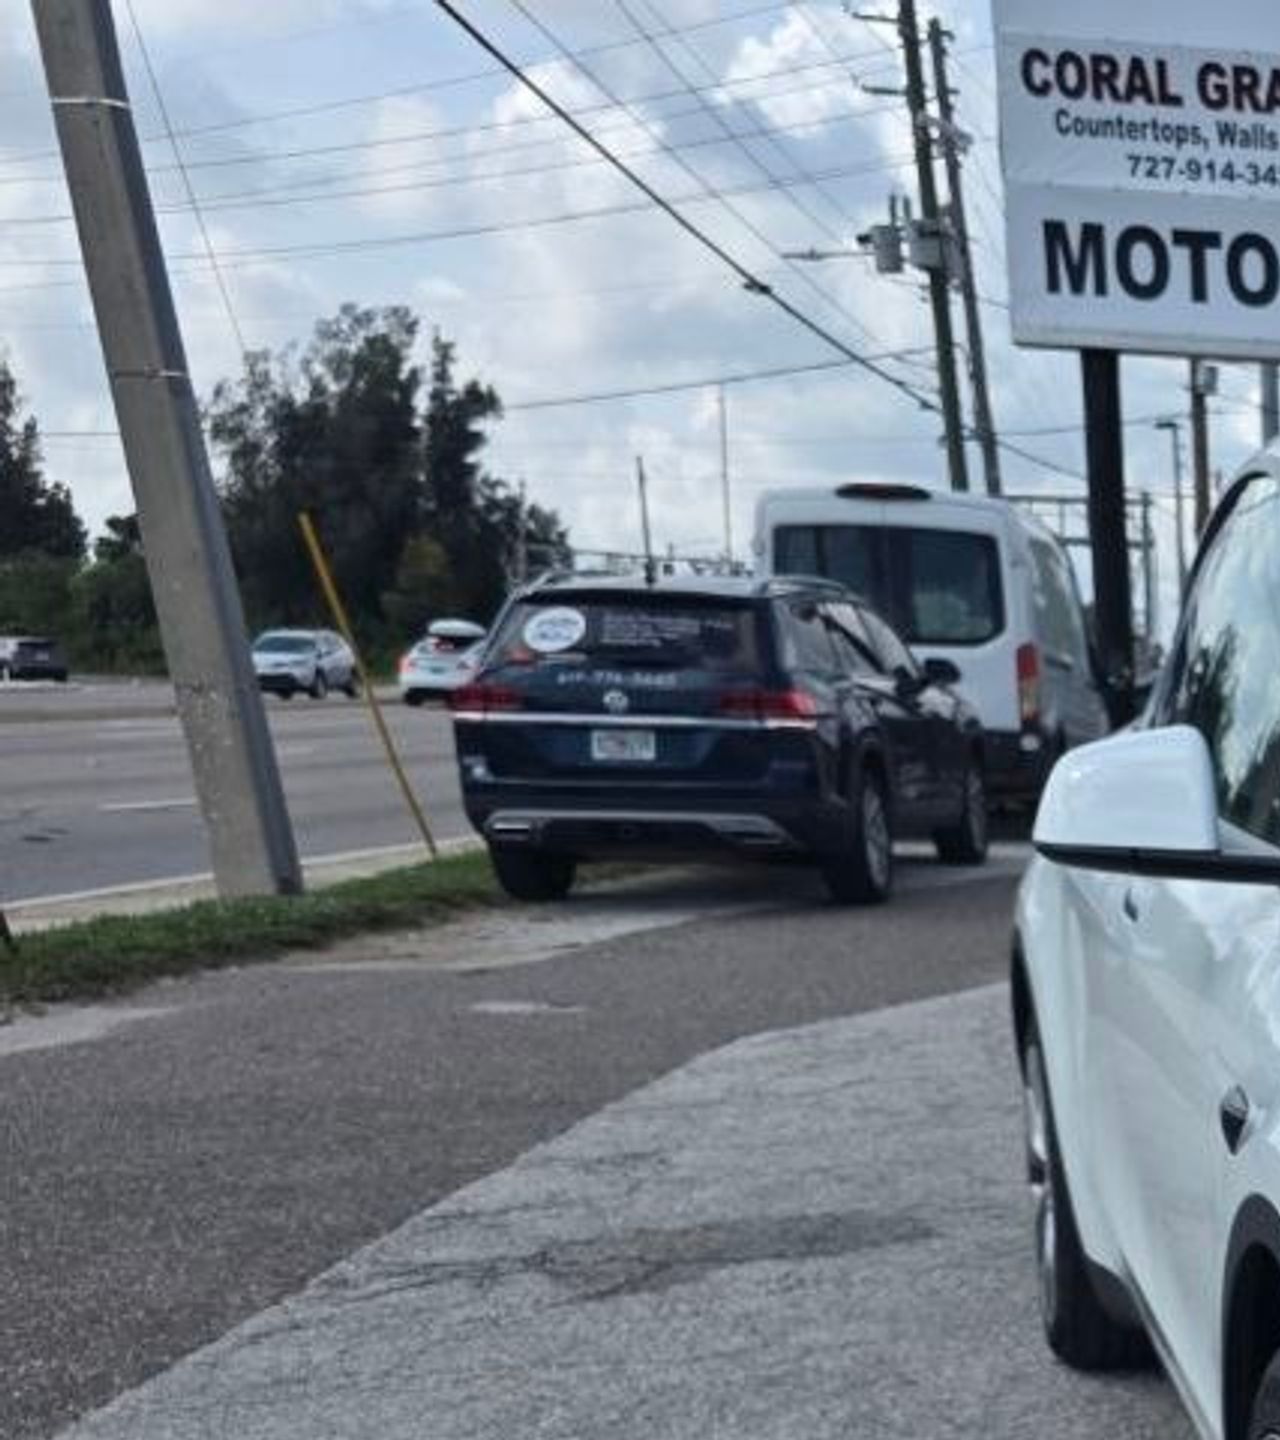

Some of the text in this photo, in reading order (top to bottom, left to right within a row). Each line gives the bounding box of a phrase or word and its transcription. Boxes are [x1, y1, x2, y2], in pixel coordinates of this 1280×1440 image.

[1020, 48, 1184, 108] CORAL
[1055, 108, 1210, 152] Countertops,
[1216, 120, 1279, 153] Walls
